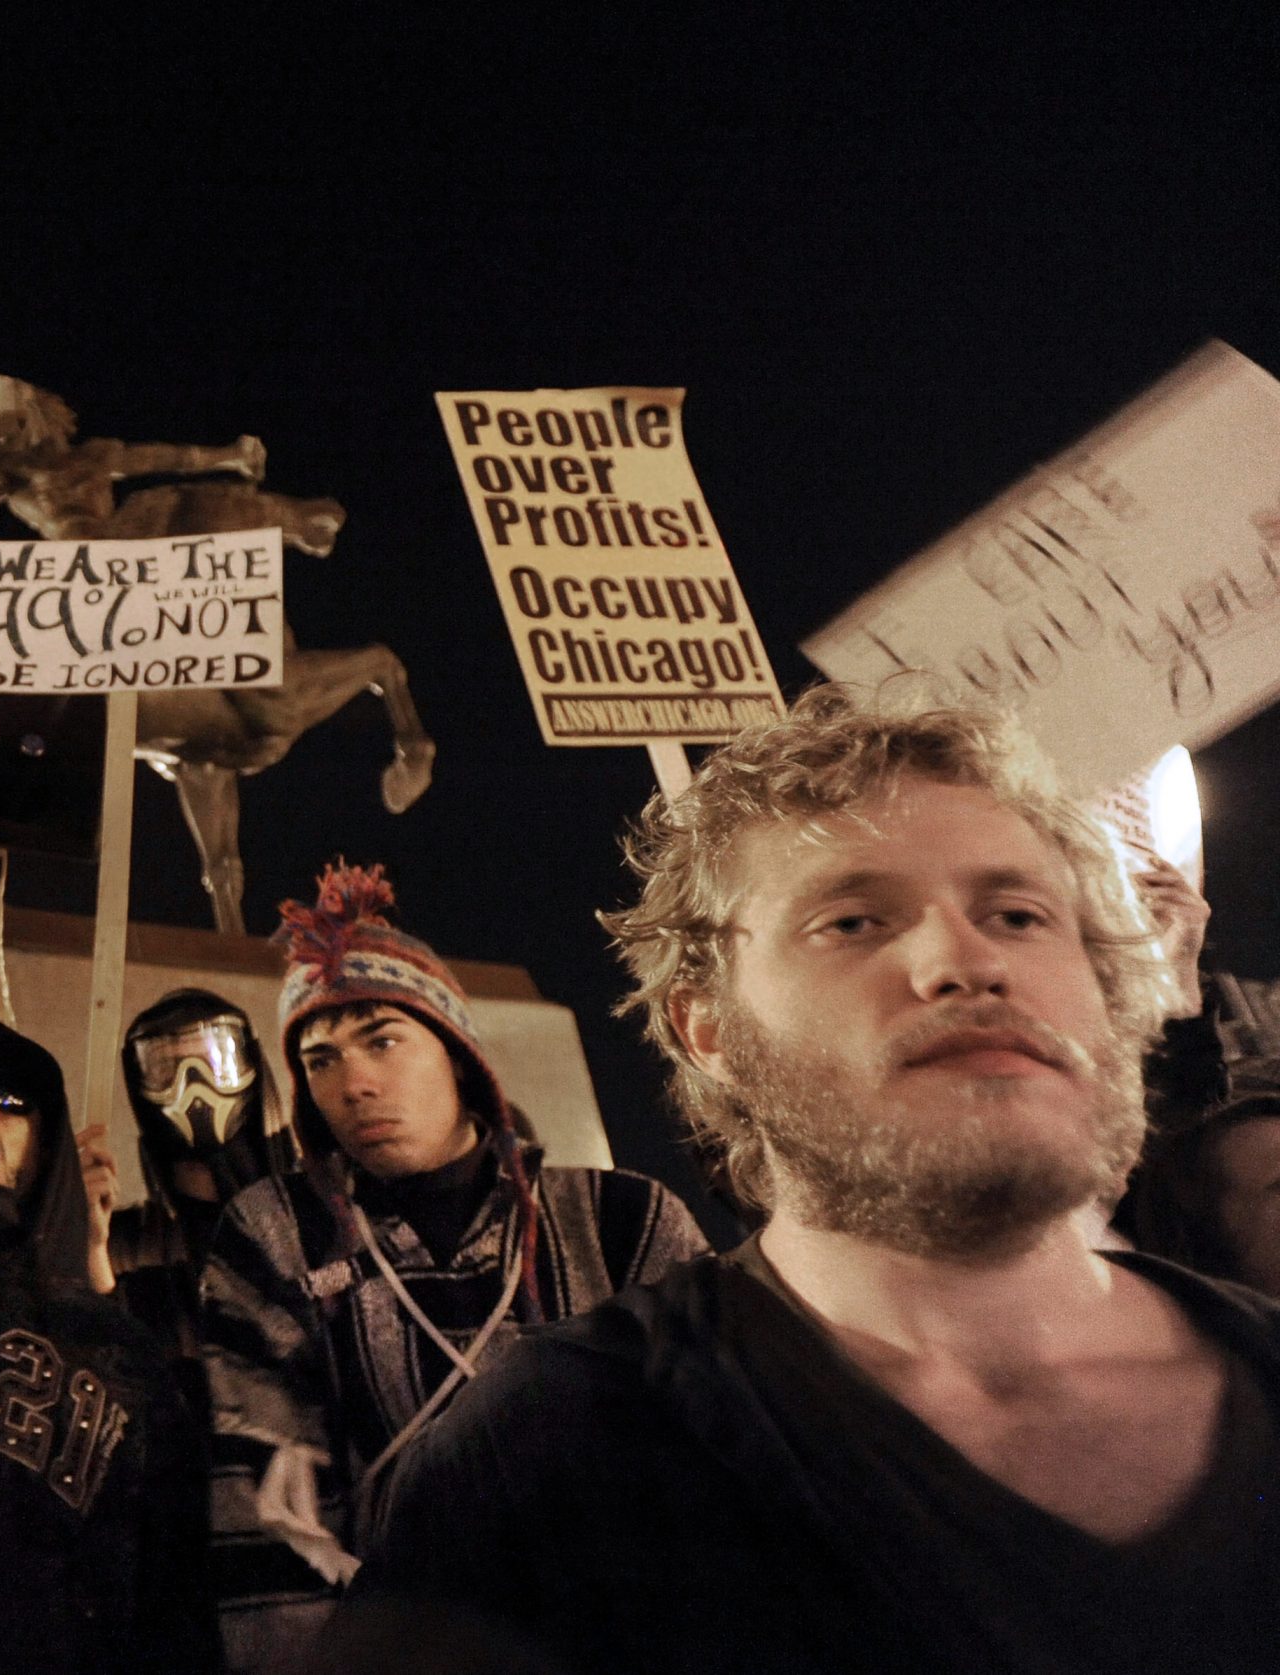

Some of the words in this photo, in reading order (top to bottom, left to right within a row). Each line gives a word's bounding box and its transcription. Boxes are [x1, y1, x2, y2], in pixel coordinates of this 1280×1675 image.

[454, 397, 672, 451] People
[473, 454, 616, 494] over
[484, 495, 710, 547] Profits!
[61, 544, 159, 586] ARE
[171, 536, 270, 581] THE
[153, 593, 280, 640] NOT
[154, 588, 184, 602] WE
[191, 584, 243, 599] WILL
[509, 566, 738, 623] Occupy
[52, 653, 272, 689] IGNORED
[528, 628, 765, 689] Chicago!
